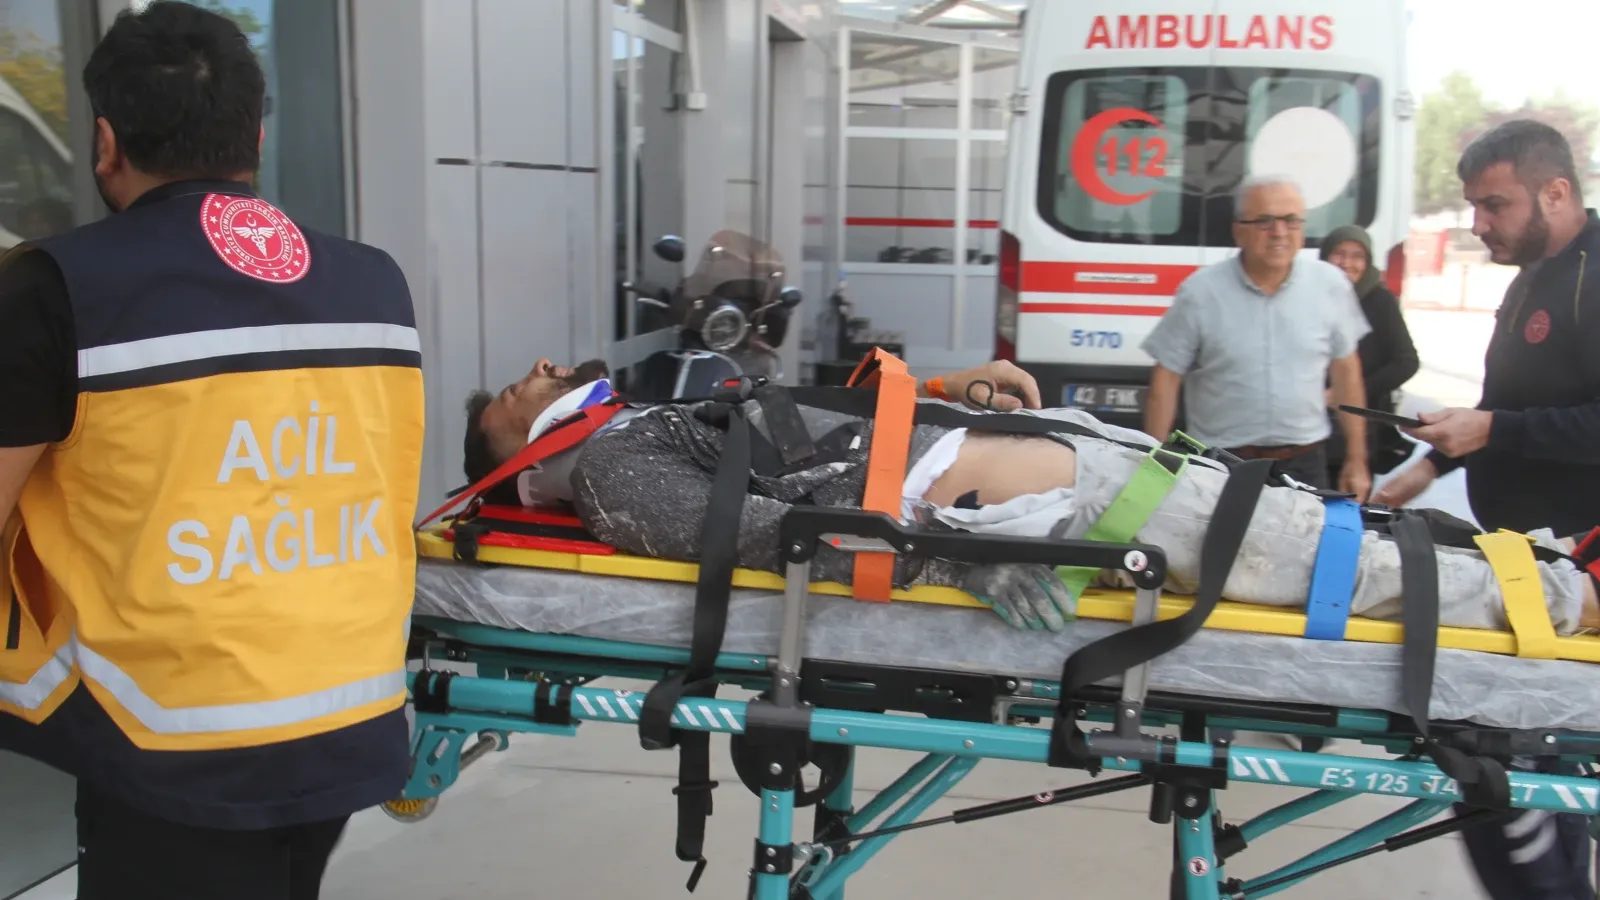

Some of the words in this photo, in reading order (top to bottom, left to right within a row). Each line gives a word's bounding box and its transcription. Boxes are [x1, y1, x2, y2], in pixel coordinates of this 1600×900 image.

[1085, 14, 1335, 50] AMBULANS
[1101, 136, 1168, 177] 112
[1070, 329, 1123, 348] 5170
[216, 400, 356, 484] ACİL
[167, 495, 387, 585] SAĞLIK
[1365, 772, 1409, 793] 125
